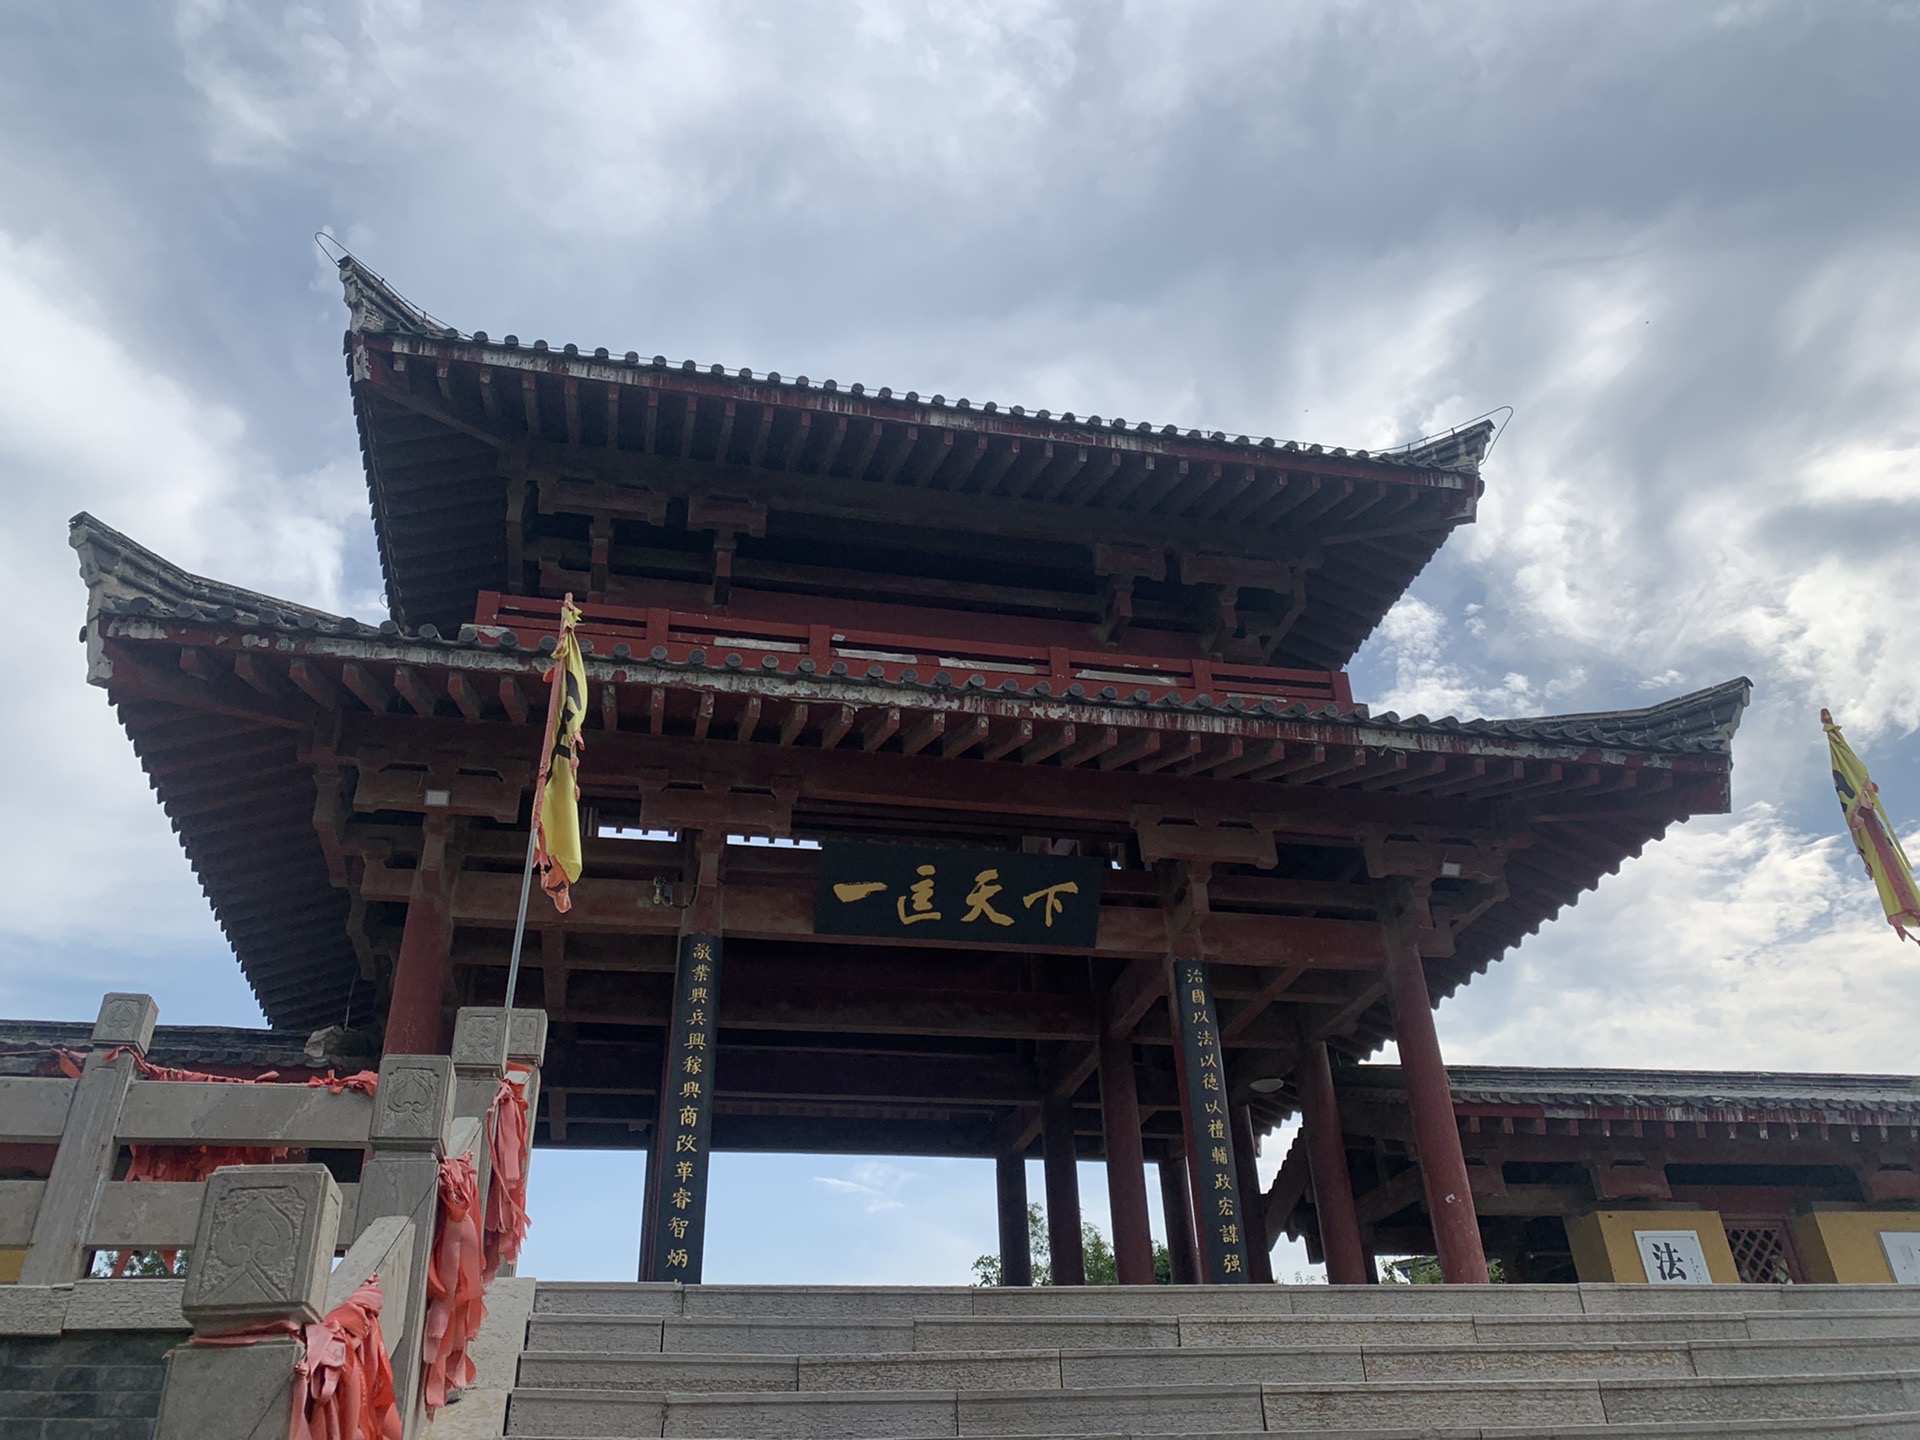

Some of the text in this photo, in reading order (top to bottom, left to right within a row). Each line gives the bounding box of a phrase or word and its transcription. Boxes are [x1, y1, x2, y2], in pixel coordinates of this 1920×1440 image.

[833, 864, 1078, 927] 一匡天下
[1652, 1242, 1687, 1281] 法
